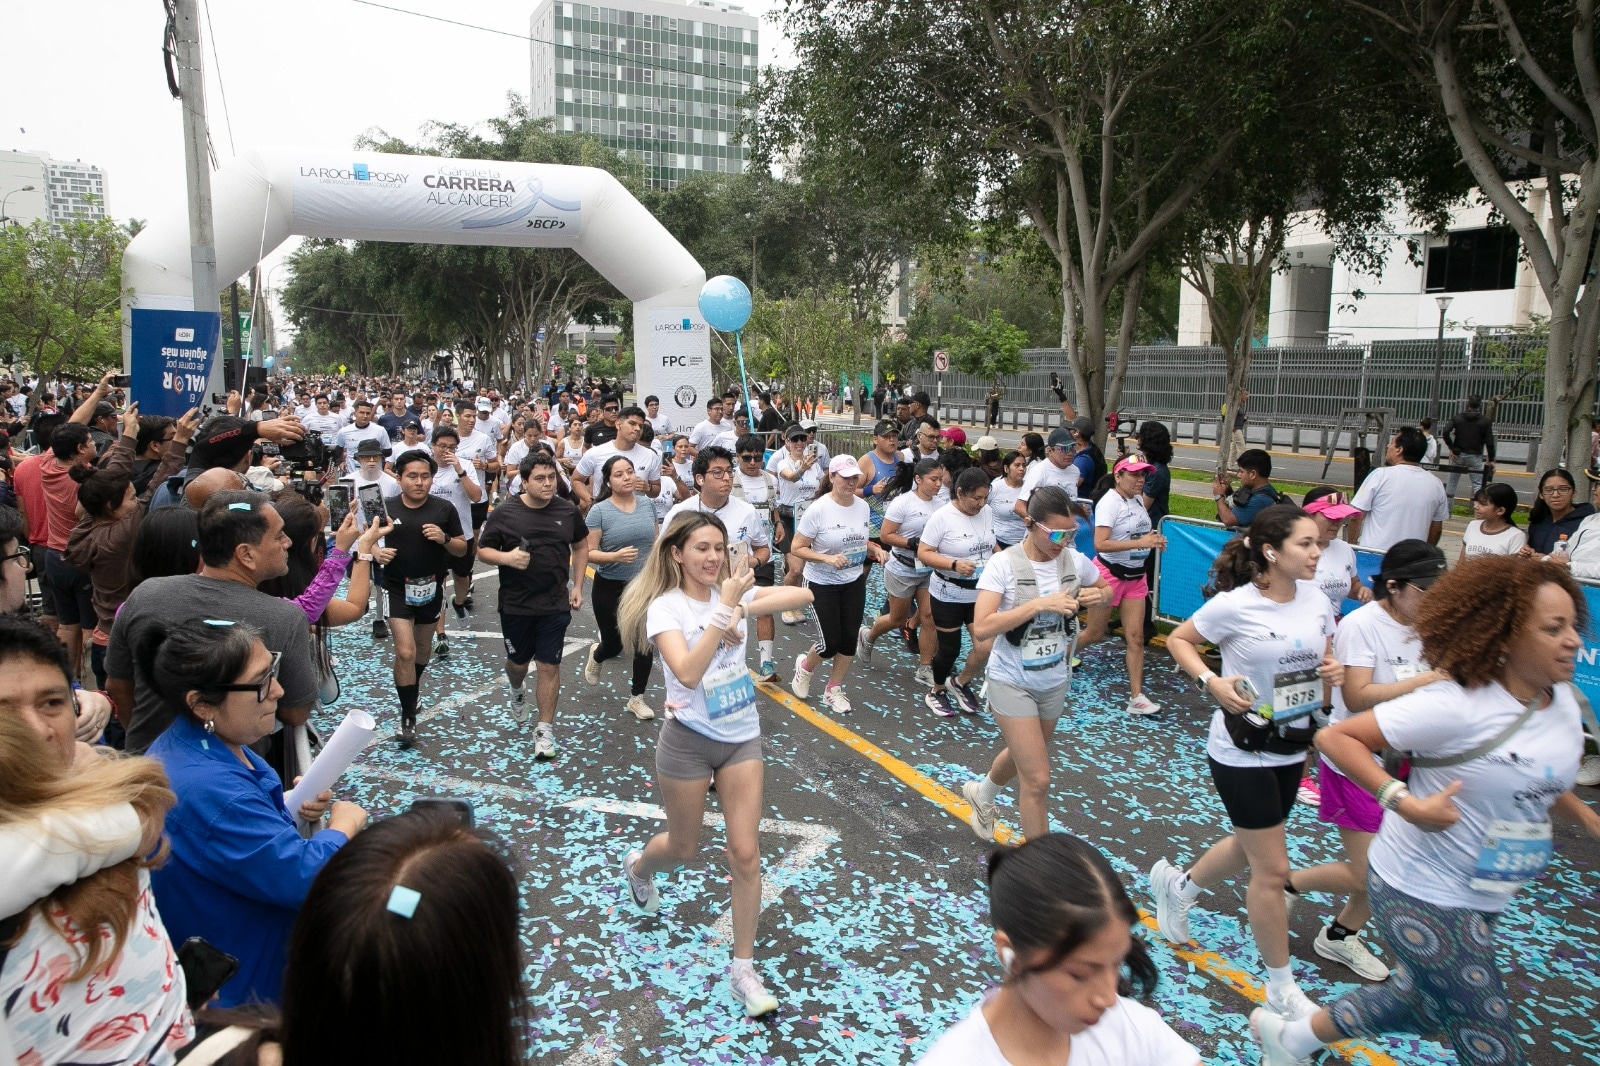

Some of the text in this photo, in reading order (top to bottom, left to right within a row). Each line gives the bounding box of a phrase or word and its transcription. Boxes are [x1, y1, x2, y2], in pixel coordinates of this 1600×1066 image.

[300, 166, 409, 183] LA ROCHE POSAY
[423, 174, 516, 193] CARRERA
[426, 190, 512, 208] AL CÁNCER!
[161, 347, 208, 362] alguien más
[662, 355, 686, 367] FPC
[162, 371, 205, 395] VALOR
[1035, 643, 1058, 657] 457
[718, 685, 748, 709] 3531
[1284, 688, 1316, 707] 1878
